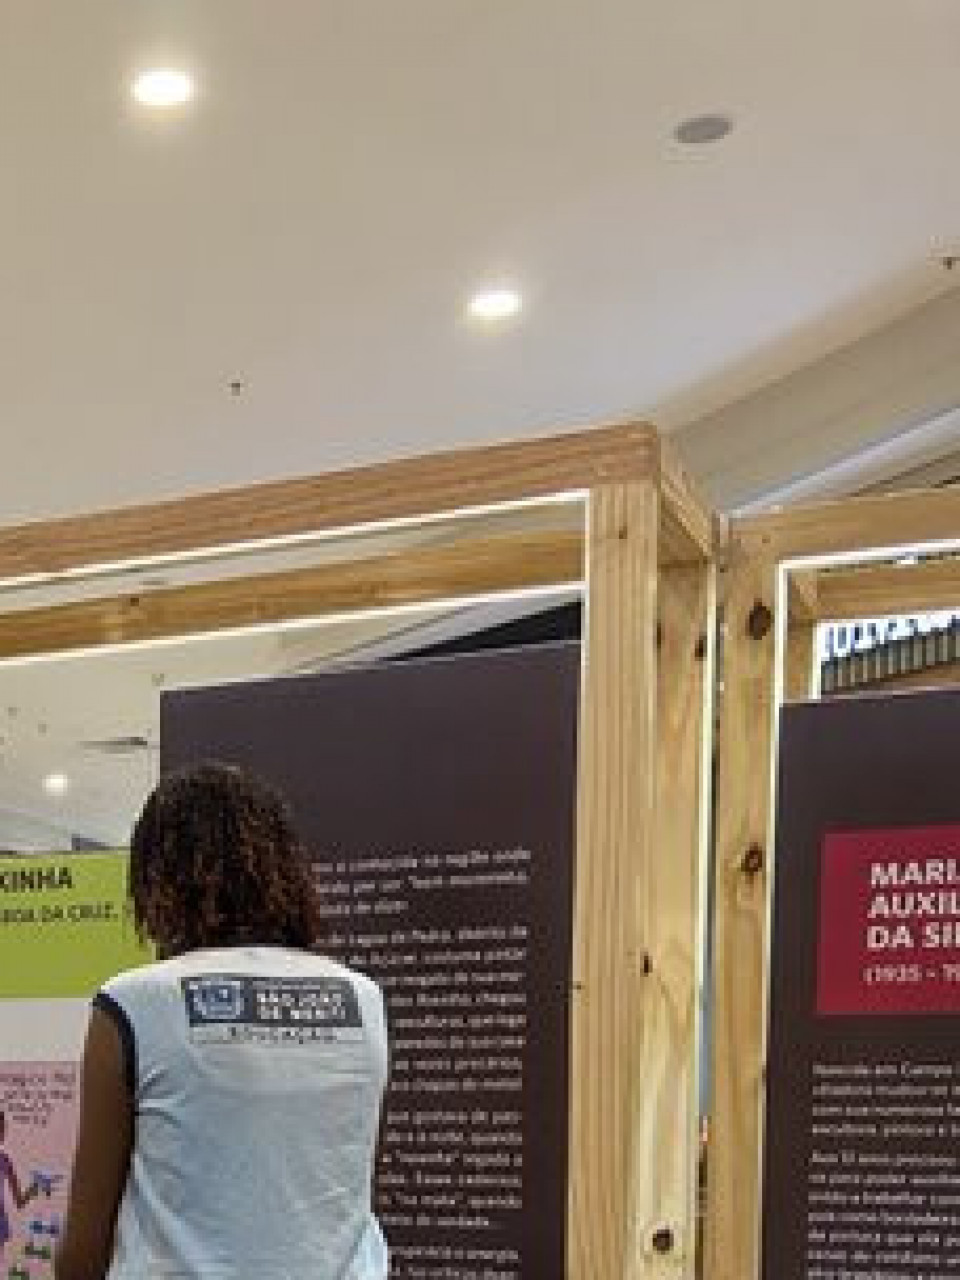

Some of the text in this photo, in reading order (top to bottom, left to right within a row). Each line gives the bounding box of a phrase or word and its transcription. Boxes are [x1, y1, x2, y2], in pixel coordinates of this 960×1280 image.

[871, 859, 960, 887] MARI
[41, 904, 64, 921] DA
[866, 924, 914, 949] DA
